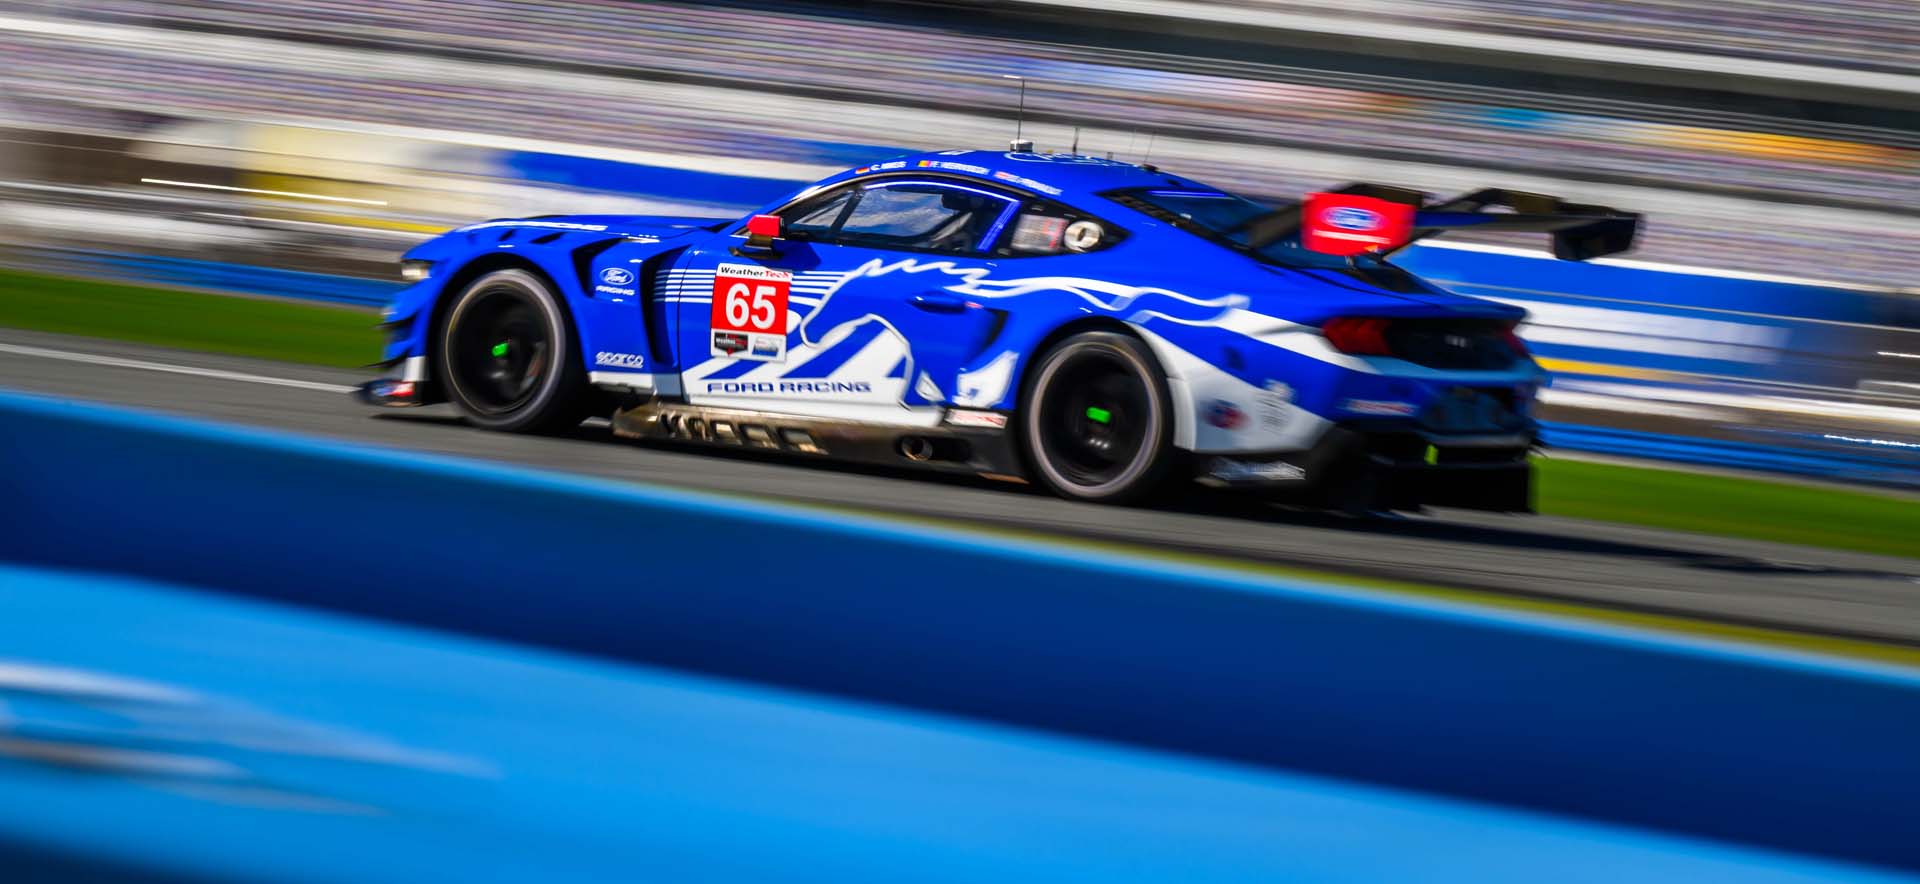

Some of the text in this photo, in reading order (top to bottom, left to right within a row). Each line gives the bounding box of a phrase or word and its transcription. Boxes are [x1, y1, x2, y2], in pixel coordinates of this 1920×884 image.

[720, 266, 790, 279] WeatherTech
[725, 282, 777, 330] 65
[707, 381, 873, 393] FORD RACING
